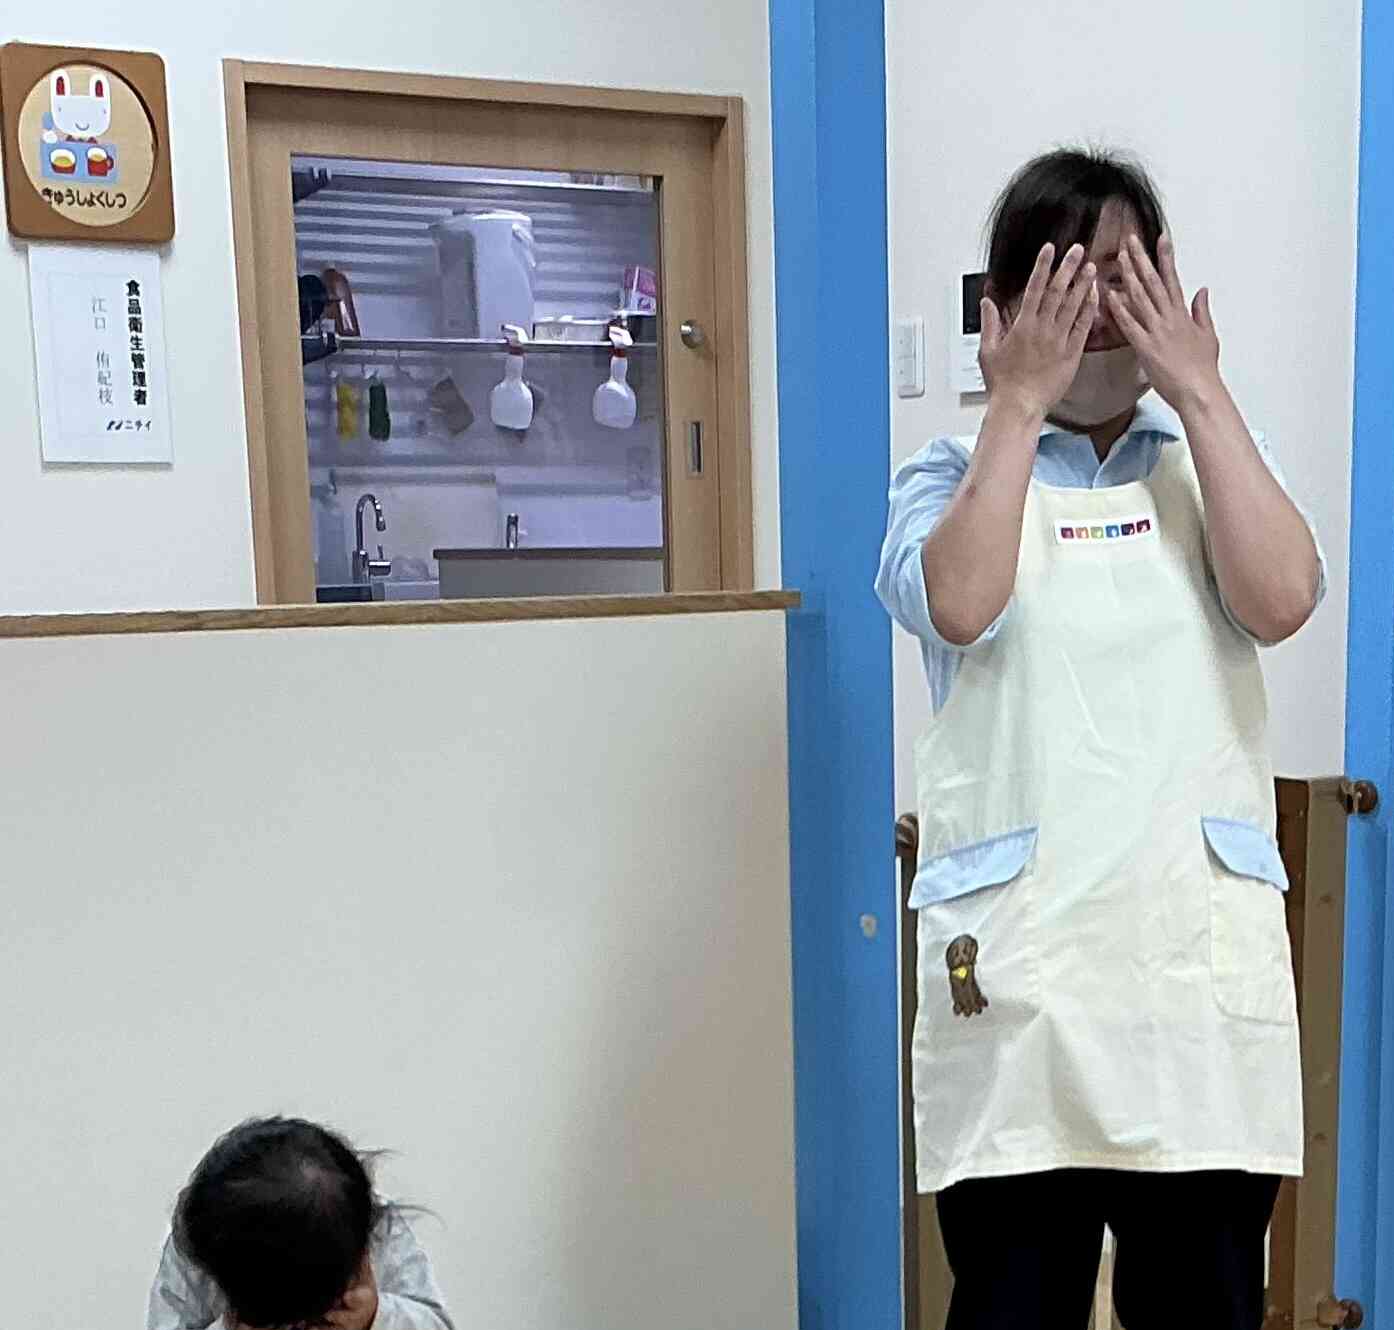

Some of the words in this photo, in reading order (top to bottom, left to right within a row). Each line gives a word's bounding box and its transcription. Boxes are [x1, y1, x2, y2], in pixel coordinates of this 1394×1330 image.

[41, 187, 127, 208] きゅうしょくしつ
[125, 279, 147, 406] 食品衛生管理者
